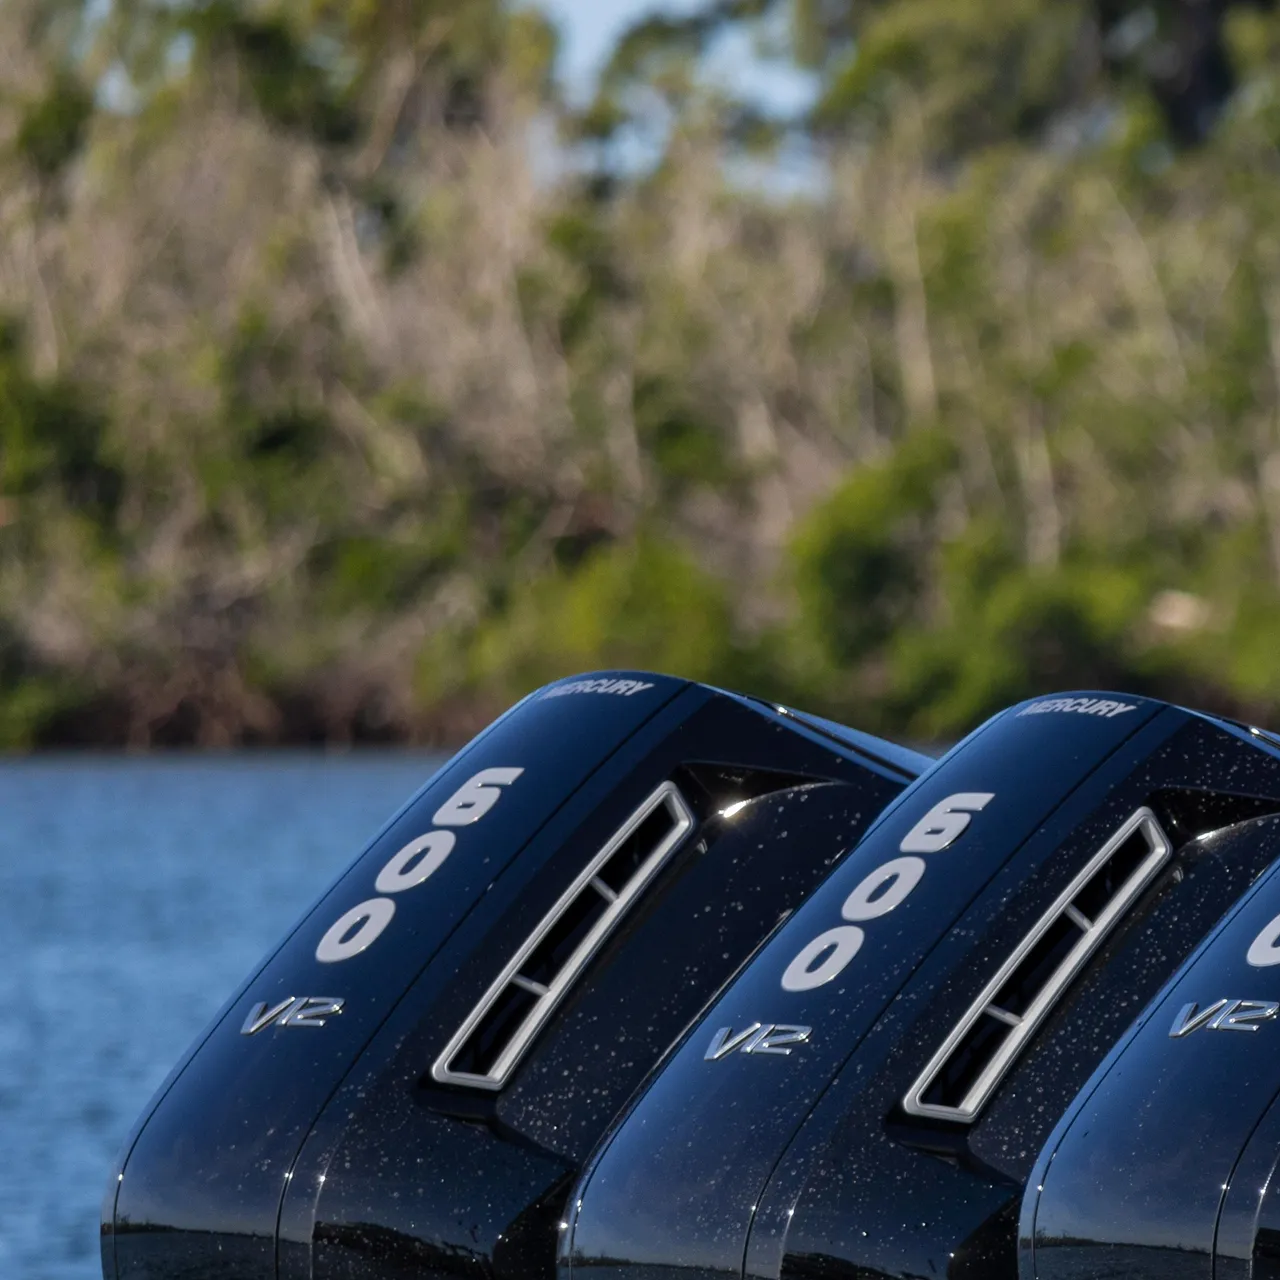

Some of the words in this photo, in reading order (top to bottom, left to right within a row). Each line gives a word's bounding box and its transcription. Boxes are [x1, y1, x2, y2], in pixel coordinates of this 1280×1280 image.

[1015, 697, 1137, 718] MERCURY
[315, 767, 525, 963] 600
[781, 792, 996, 992] 600
[240, 996, 346, 1036] V12
[1168, 998, 1280, 1038] V12
[703, 1022, 813, 1060] V12
